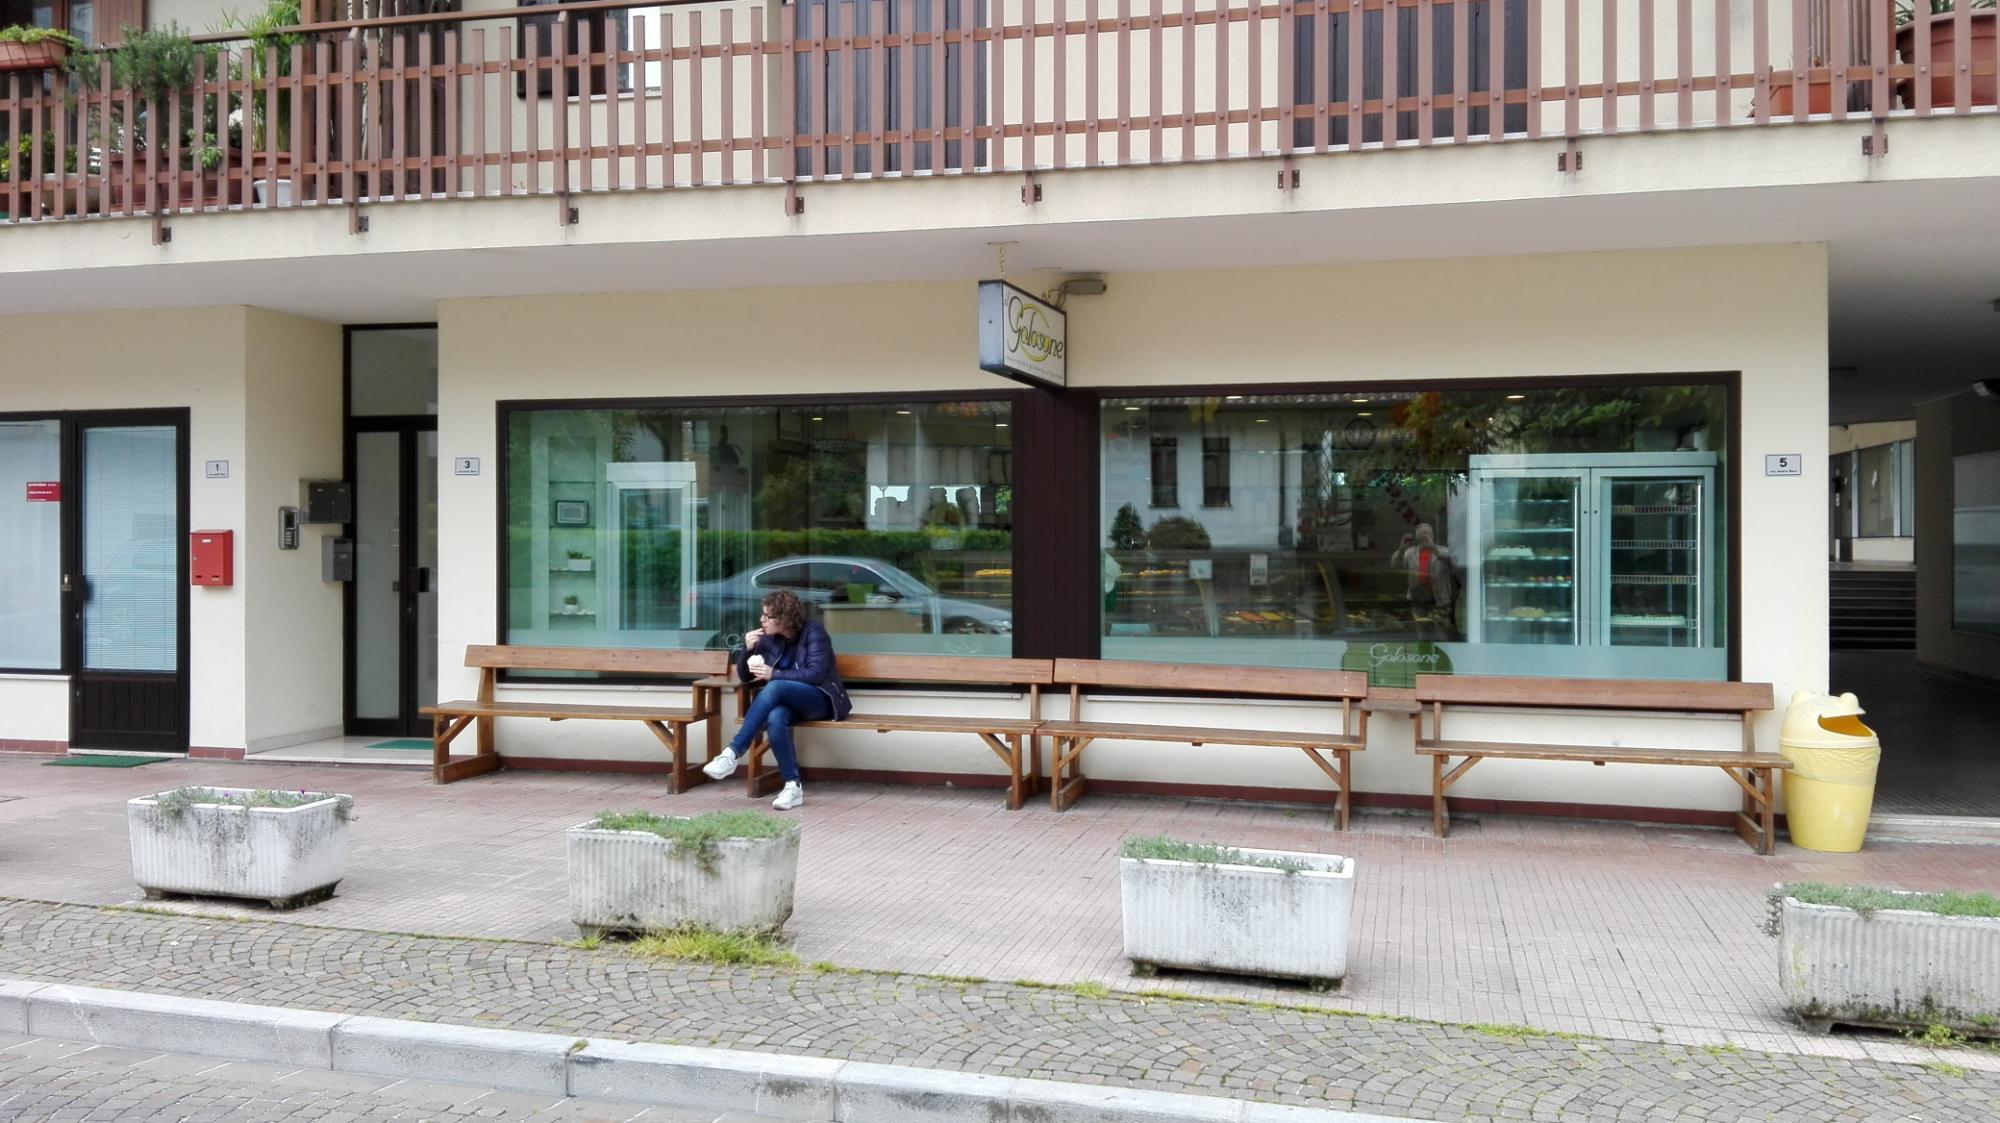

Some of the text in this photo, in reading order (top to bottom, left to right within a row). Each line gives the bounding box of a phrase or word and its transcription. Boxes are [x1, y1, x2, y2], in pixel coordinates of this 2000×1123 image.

[215, 463, 220, 472] 1
[464, 460, 471, 469] 3
[1779, 457, 1788, 468] 5
[1368, 643, 1439, 666] Golosone
